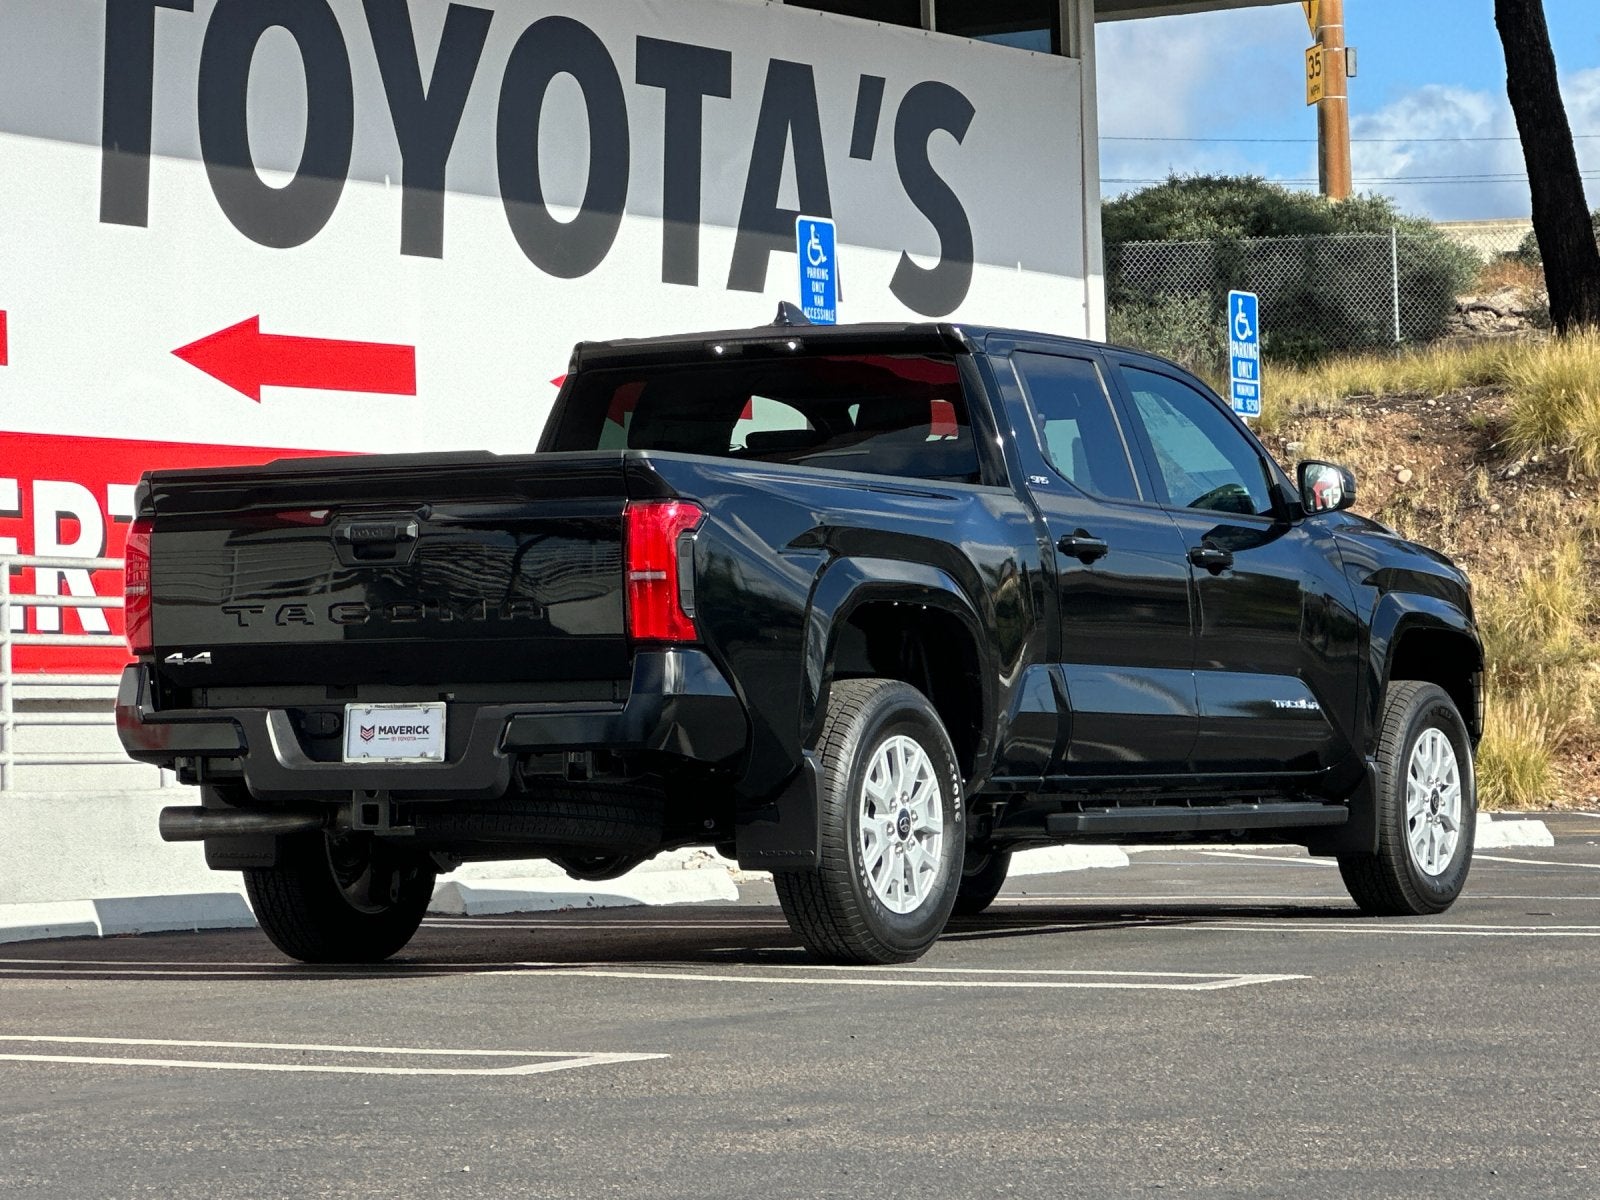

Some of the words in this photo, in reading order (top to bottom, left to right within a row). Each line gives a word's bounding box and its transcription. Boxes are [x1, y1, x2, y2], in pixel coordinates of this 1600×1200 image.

[1308, 51, 1322, 80] 35
[99, 0, 977, 318] TOYOTA'S
[806, 266, 829, 281] PARKING
[811, 281, 825, 293] ONLY
[813, 295, 825, 307] VAN
[803, 306, 835, 321] ACCESSIBLE
[1232, 341, 1257, 360] PARKING
[1237, 360, 1253, 378] ONLY
[1236, 383, 1255, 397] MINIMUM
[1234, 397, 1245, 410] FINE
[221, 600, 544, 627] TACOMA
[1271, 699, 1320, 710] TACOMA
[378, 725, 430, 735] MAVERICK
